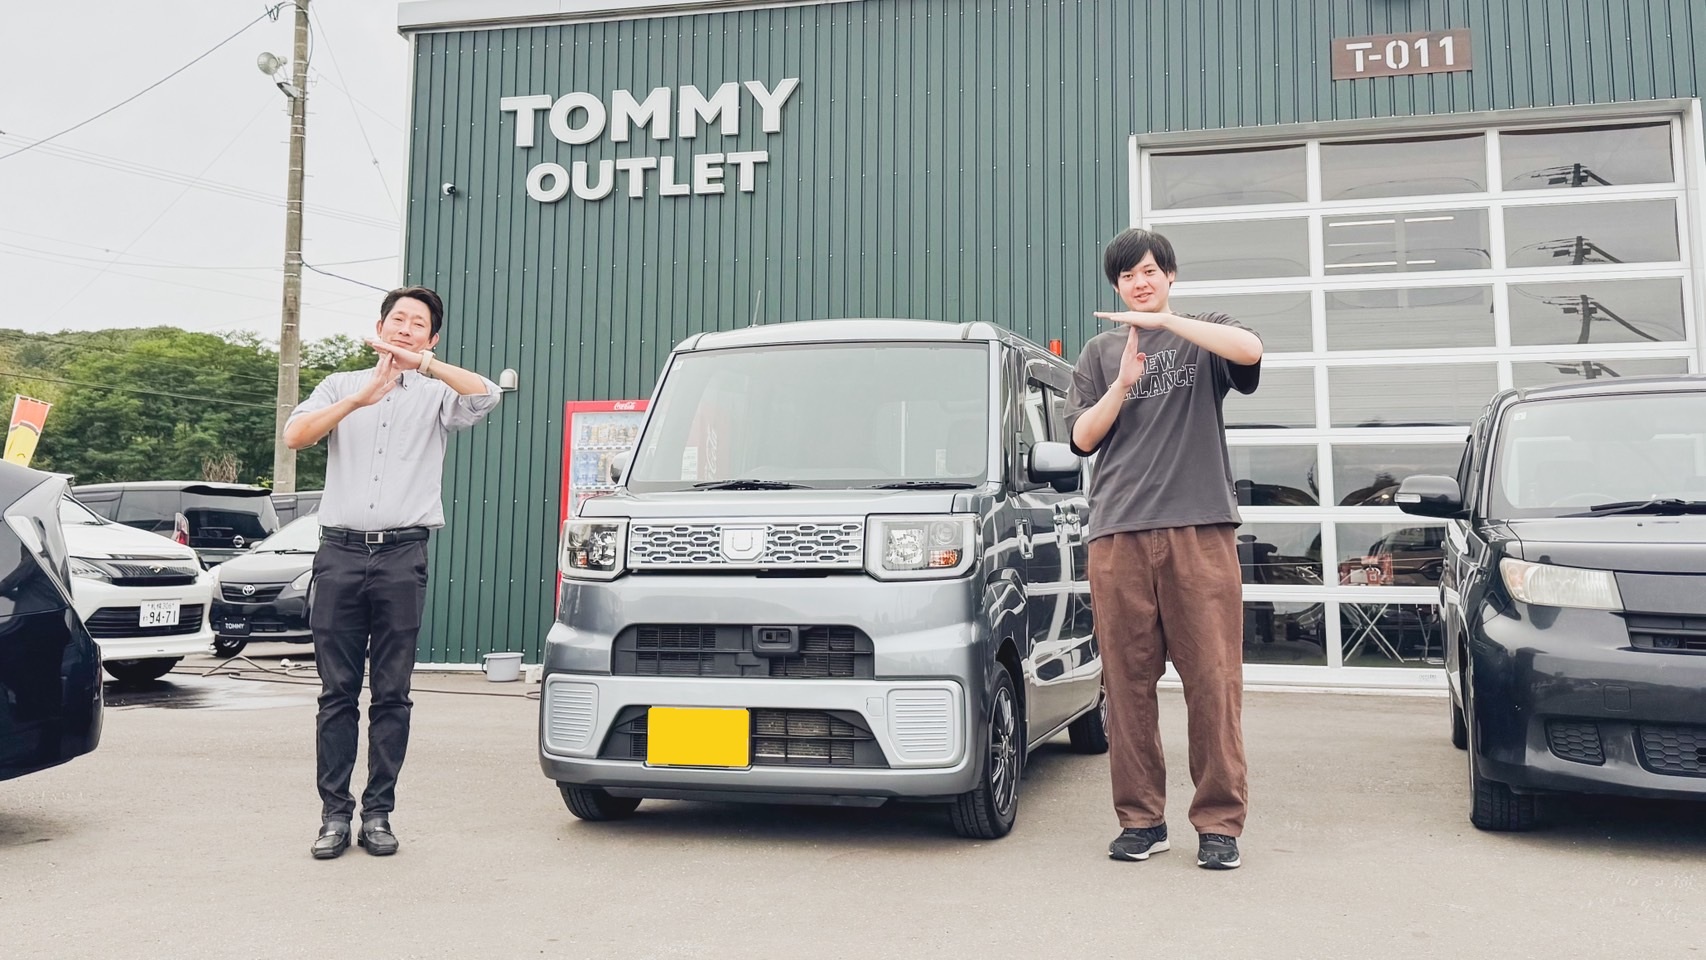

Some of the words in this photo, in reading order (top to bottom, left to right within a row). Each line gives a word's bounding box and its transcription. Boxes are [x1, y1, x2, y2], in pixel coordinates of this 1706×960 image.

[1346, 36, 1454, 72] T-011
[500, 77, 800, 148] TOMMY
[526, 150, 769, 203] OUTLET
